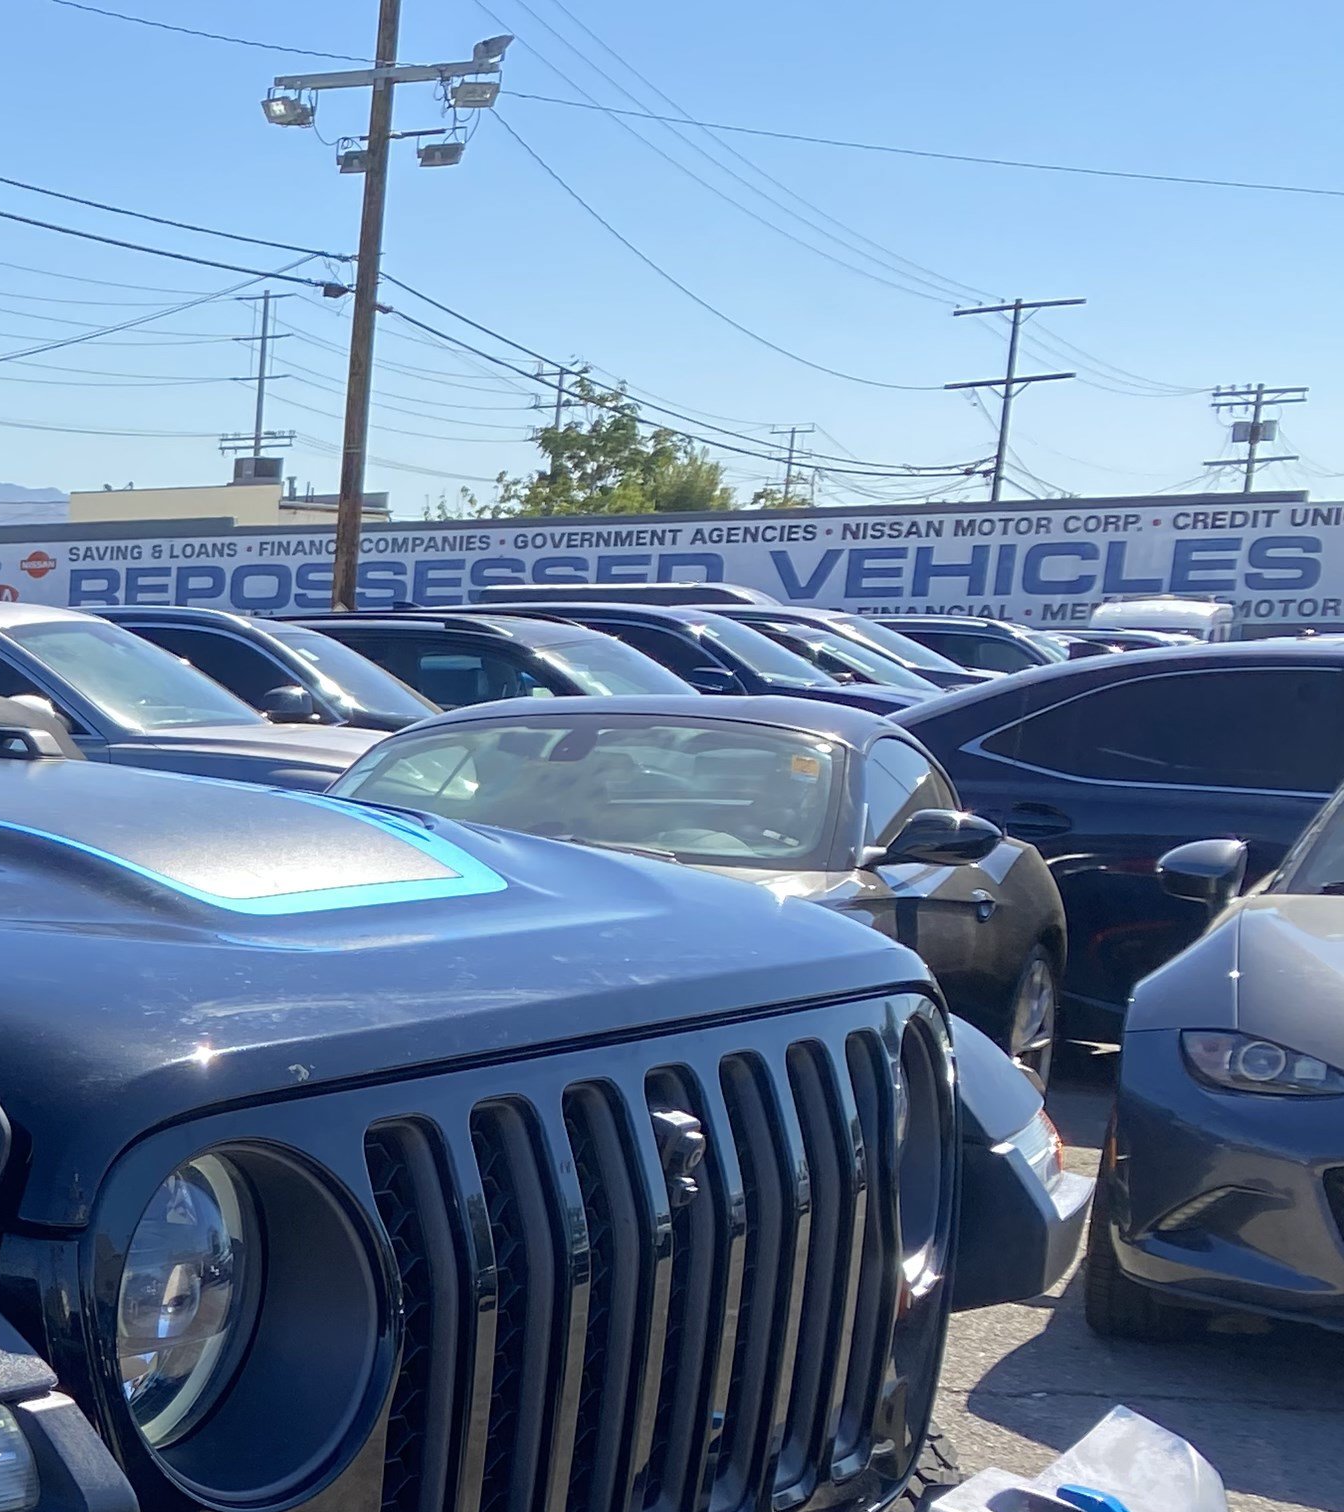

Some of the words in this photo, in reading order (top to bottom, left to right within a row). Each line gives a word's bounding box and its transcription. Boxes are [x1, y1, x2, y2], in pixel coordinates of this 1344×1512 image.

[68, 544, 143, 562] SAVING
[151, 543, 164, 560] &
[169, 542, 238, 560] LOANS
[258, 539, 337, 556] FINANC
[360, 535, 491, 554] COMPANIES
[513, 529, 683, 550] GOVERNMENT
[690, 524, 818, 546] AGENCIES
[841, 519, 945, 541] NISSAN
[953, 516, 1053, 537] MOTOR
[1063, 514, 1144, 534] CORP.
[1172, 509, 1280, 530] CREDIT
[1290, 507, 1344, 527] UNI
[21, 559, 56, 570] NISSAN
[67, 552, 725, 609] REPOSSESSED
[769, 536, 1323, 599] VEHICLES
